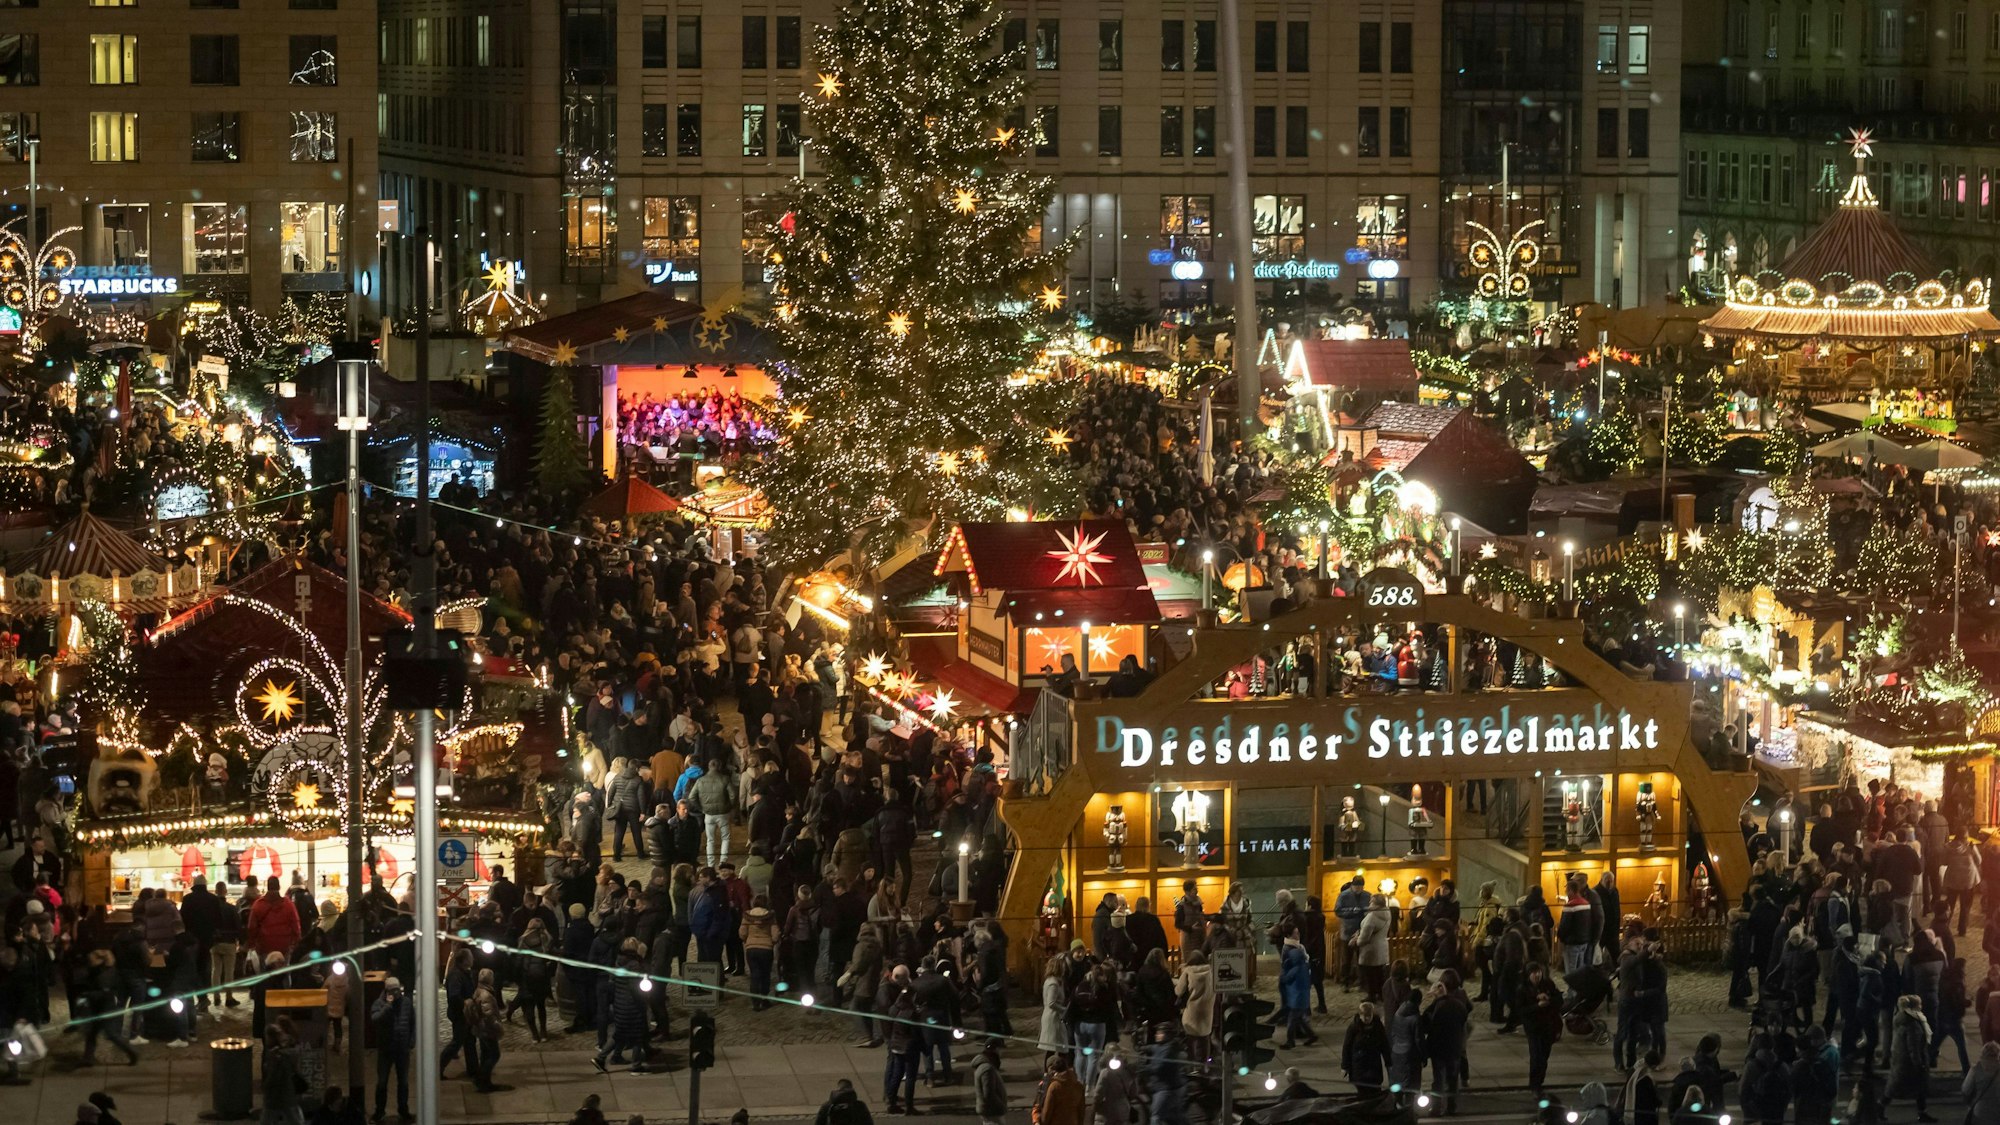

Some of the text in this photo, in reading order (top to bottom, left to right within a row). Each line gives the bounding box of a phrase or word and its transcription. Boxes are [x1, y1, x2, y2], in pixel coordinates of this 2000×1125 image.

[671, 270, 698, 282] Bank
[1253, 259, 1340, 279] cker-Pschorr
[59, 278, 178, 294] STARBUCKS
[1142, 549, 1164, 559] 2022
[1368, 586, 1418, 606] 588.
[1120, 714, 1659, 768] Dresdner Striezelmarkt
[441, 869, 464, 877] ZONE
